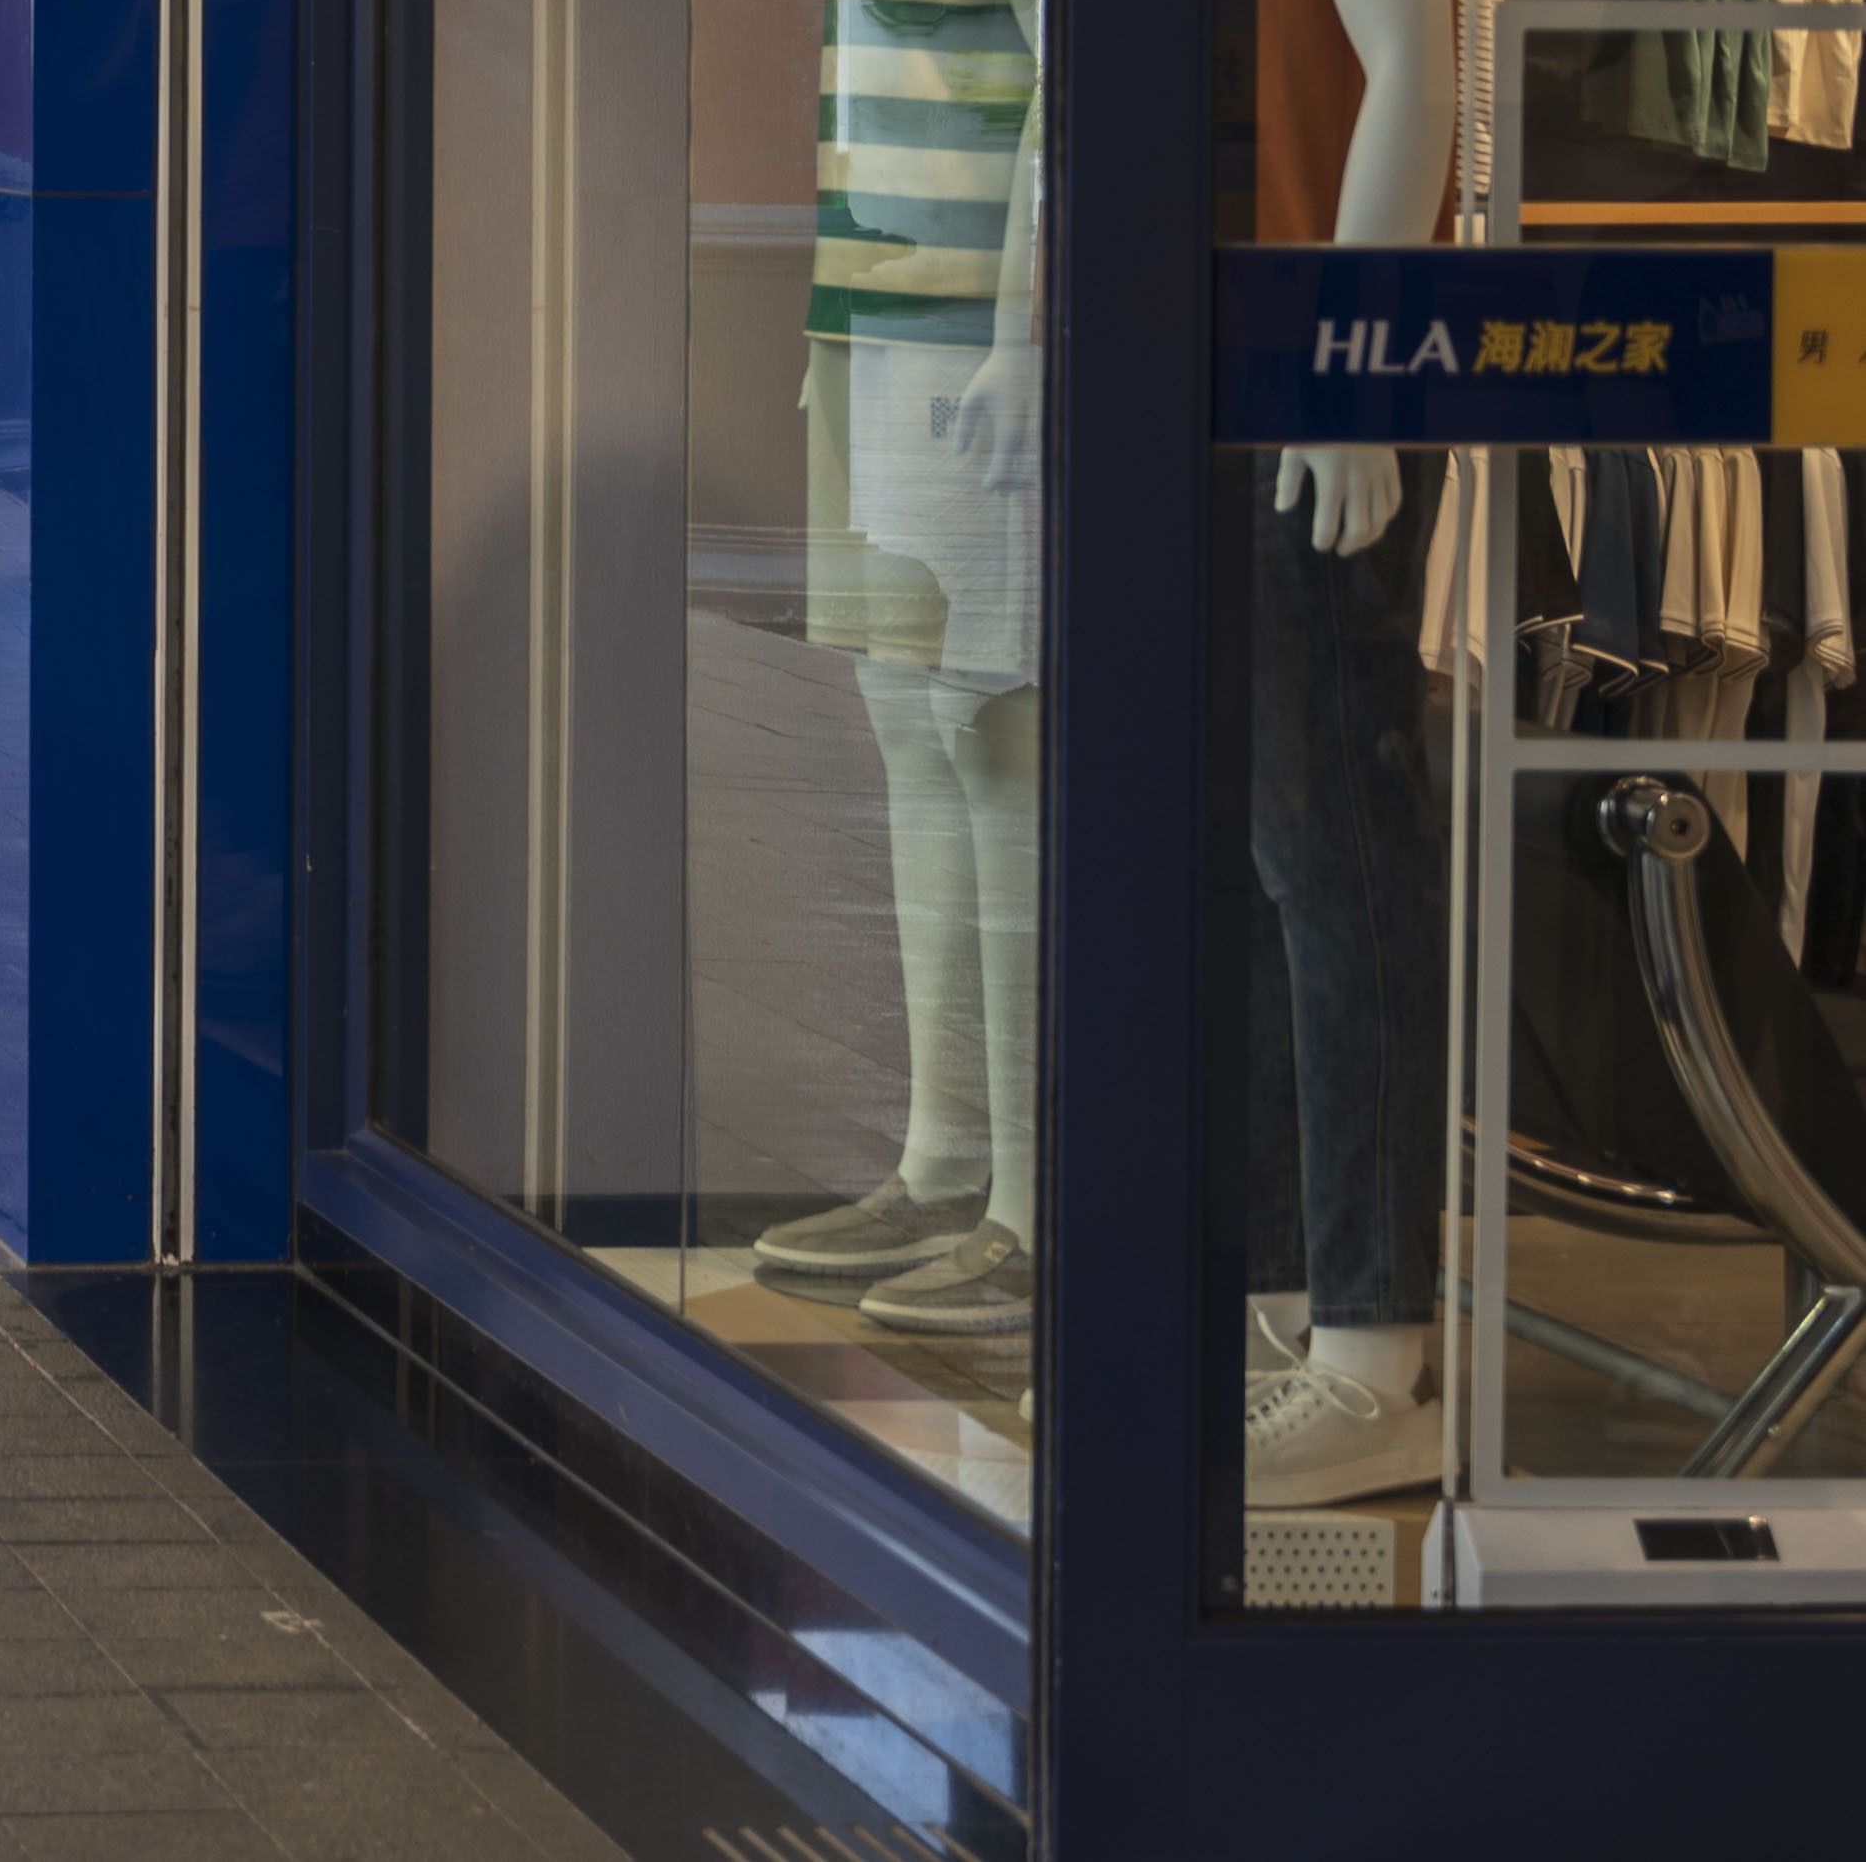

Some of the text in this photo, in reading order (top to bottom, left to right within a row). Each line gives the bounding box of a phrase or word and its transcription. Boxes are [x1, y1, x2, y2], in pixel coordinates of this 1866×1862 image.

[1312, 319, 1673, 375] HLA 海澜之家
[1796, 329, 1829, 365] 男
